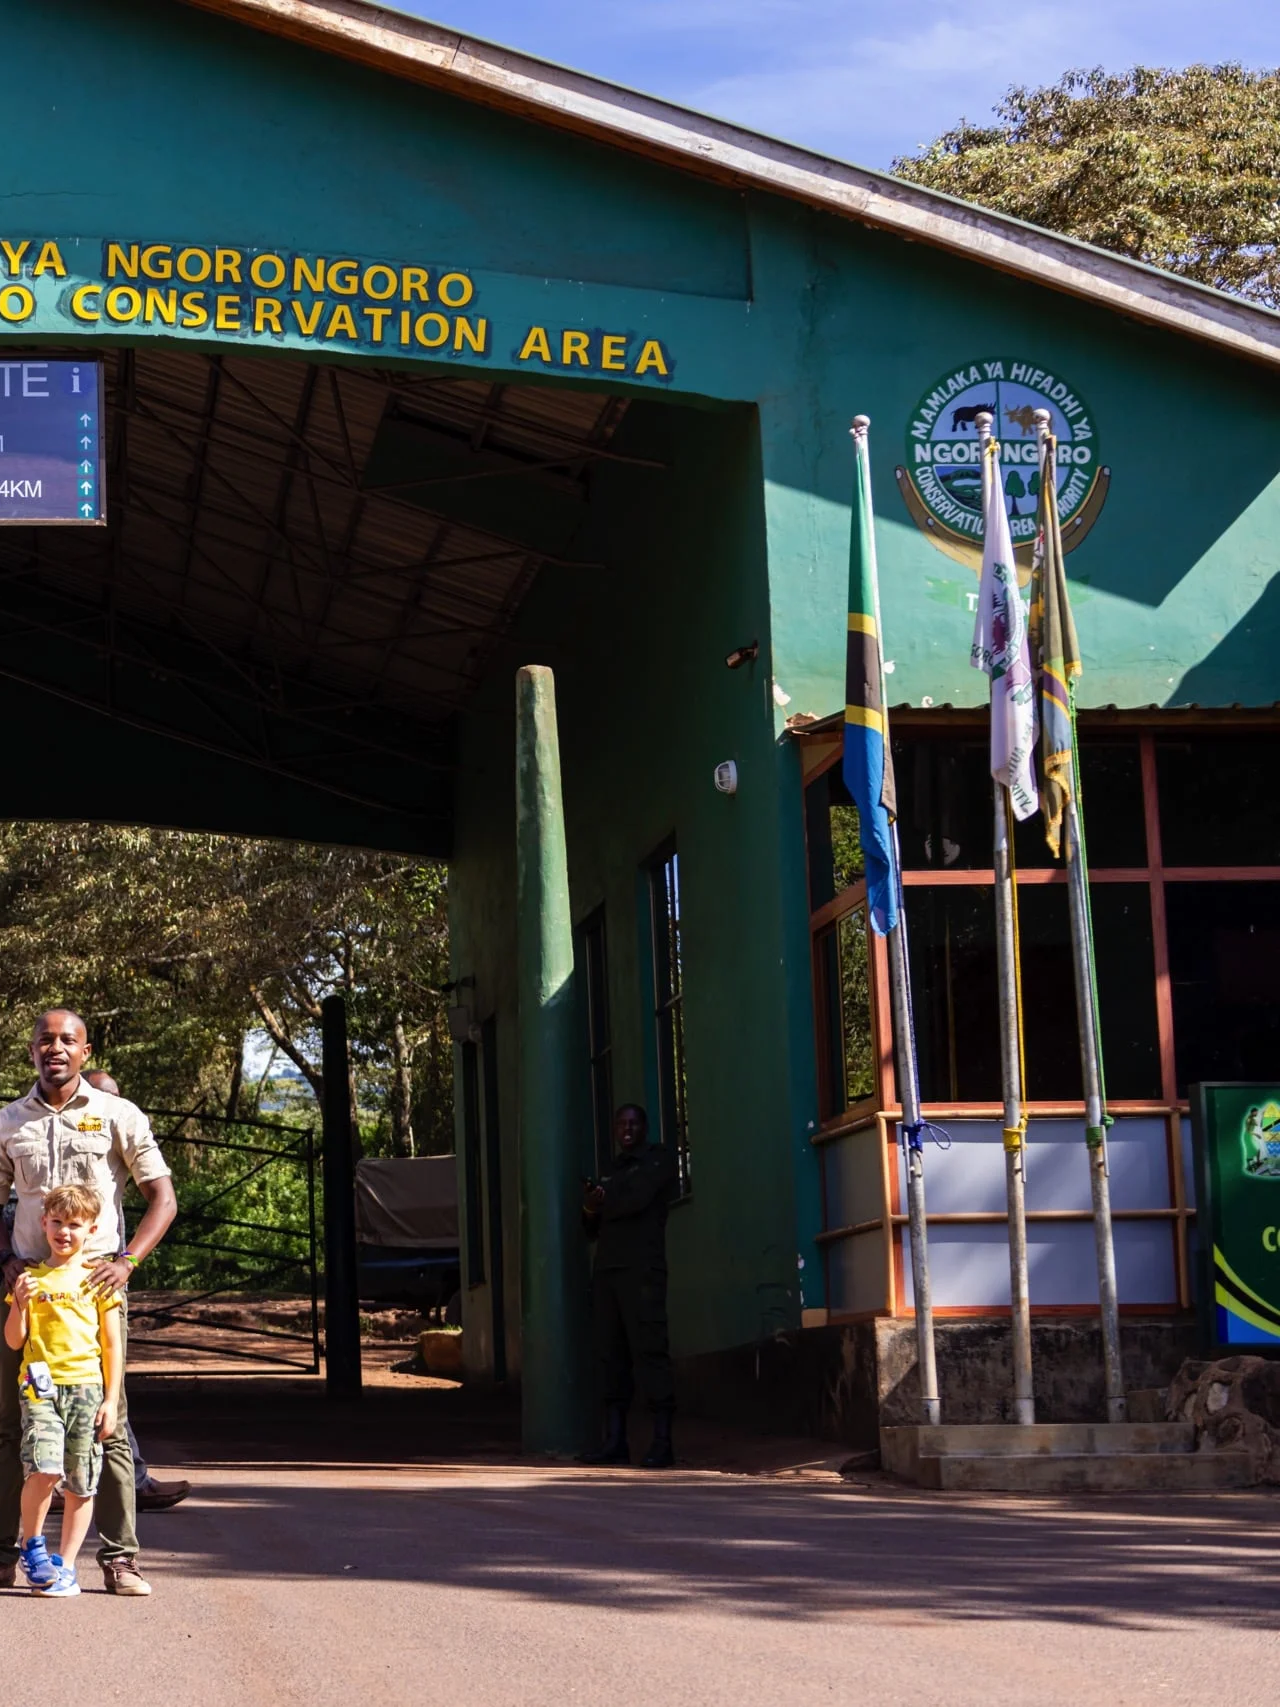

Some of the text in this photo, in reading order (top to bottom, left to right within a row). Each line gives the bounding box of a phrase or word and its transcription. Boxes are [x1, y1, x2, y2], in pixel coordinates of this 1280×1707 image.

[1, 241, 67, 276] YA
[107, 244, 473, 307] NGORONGORO
[72, 285, 487, 352] CONSERVATION
[519, 327, 667, 375] AREA
[911, 361, 1093, 442] MAMLAKA YA HIFADHI YA
